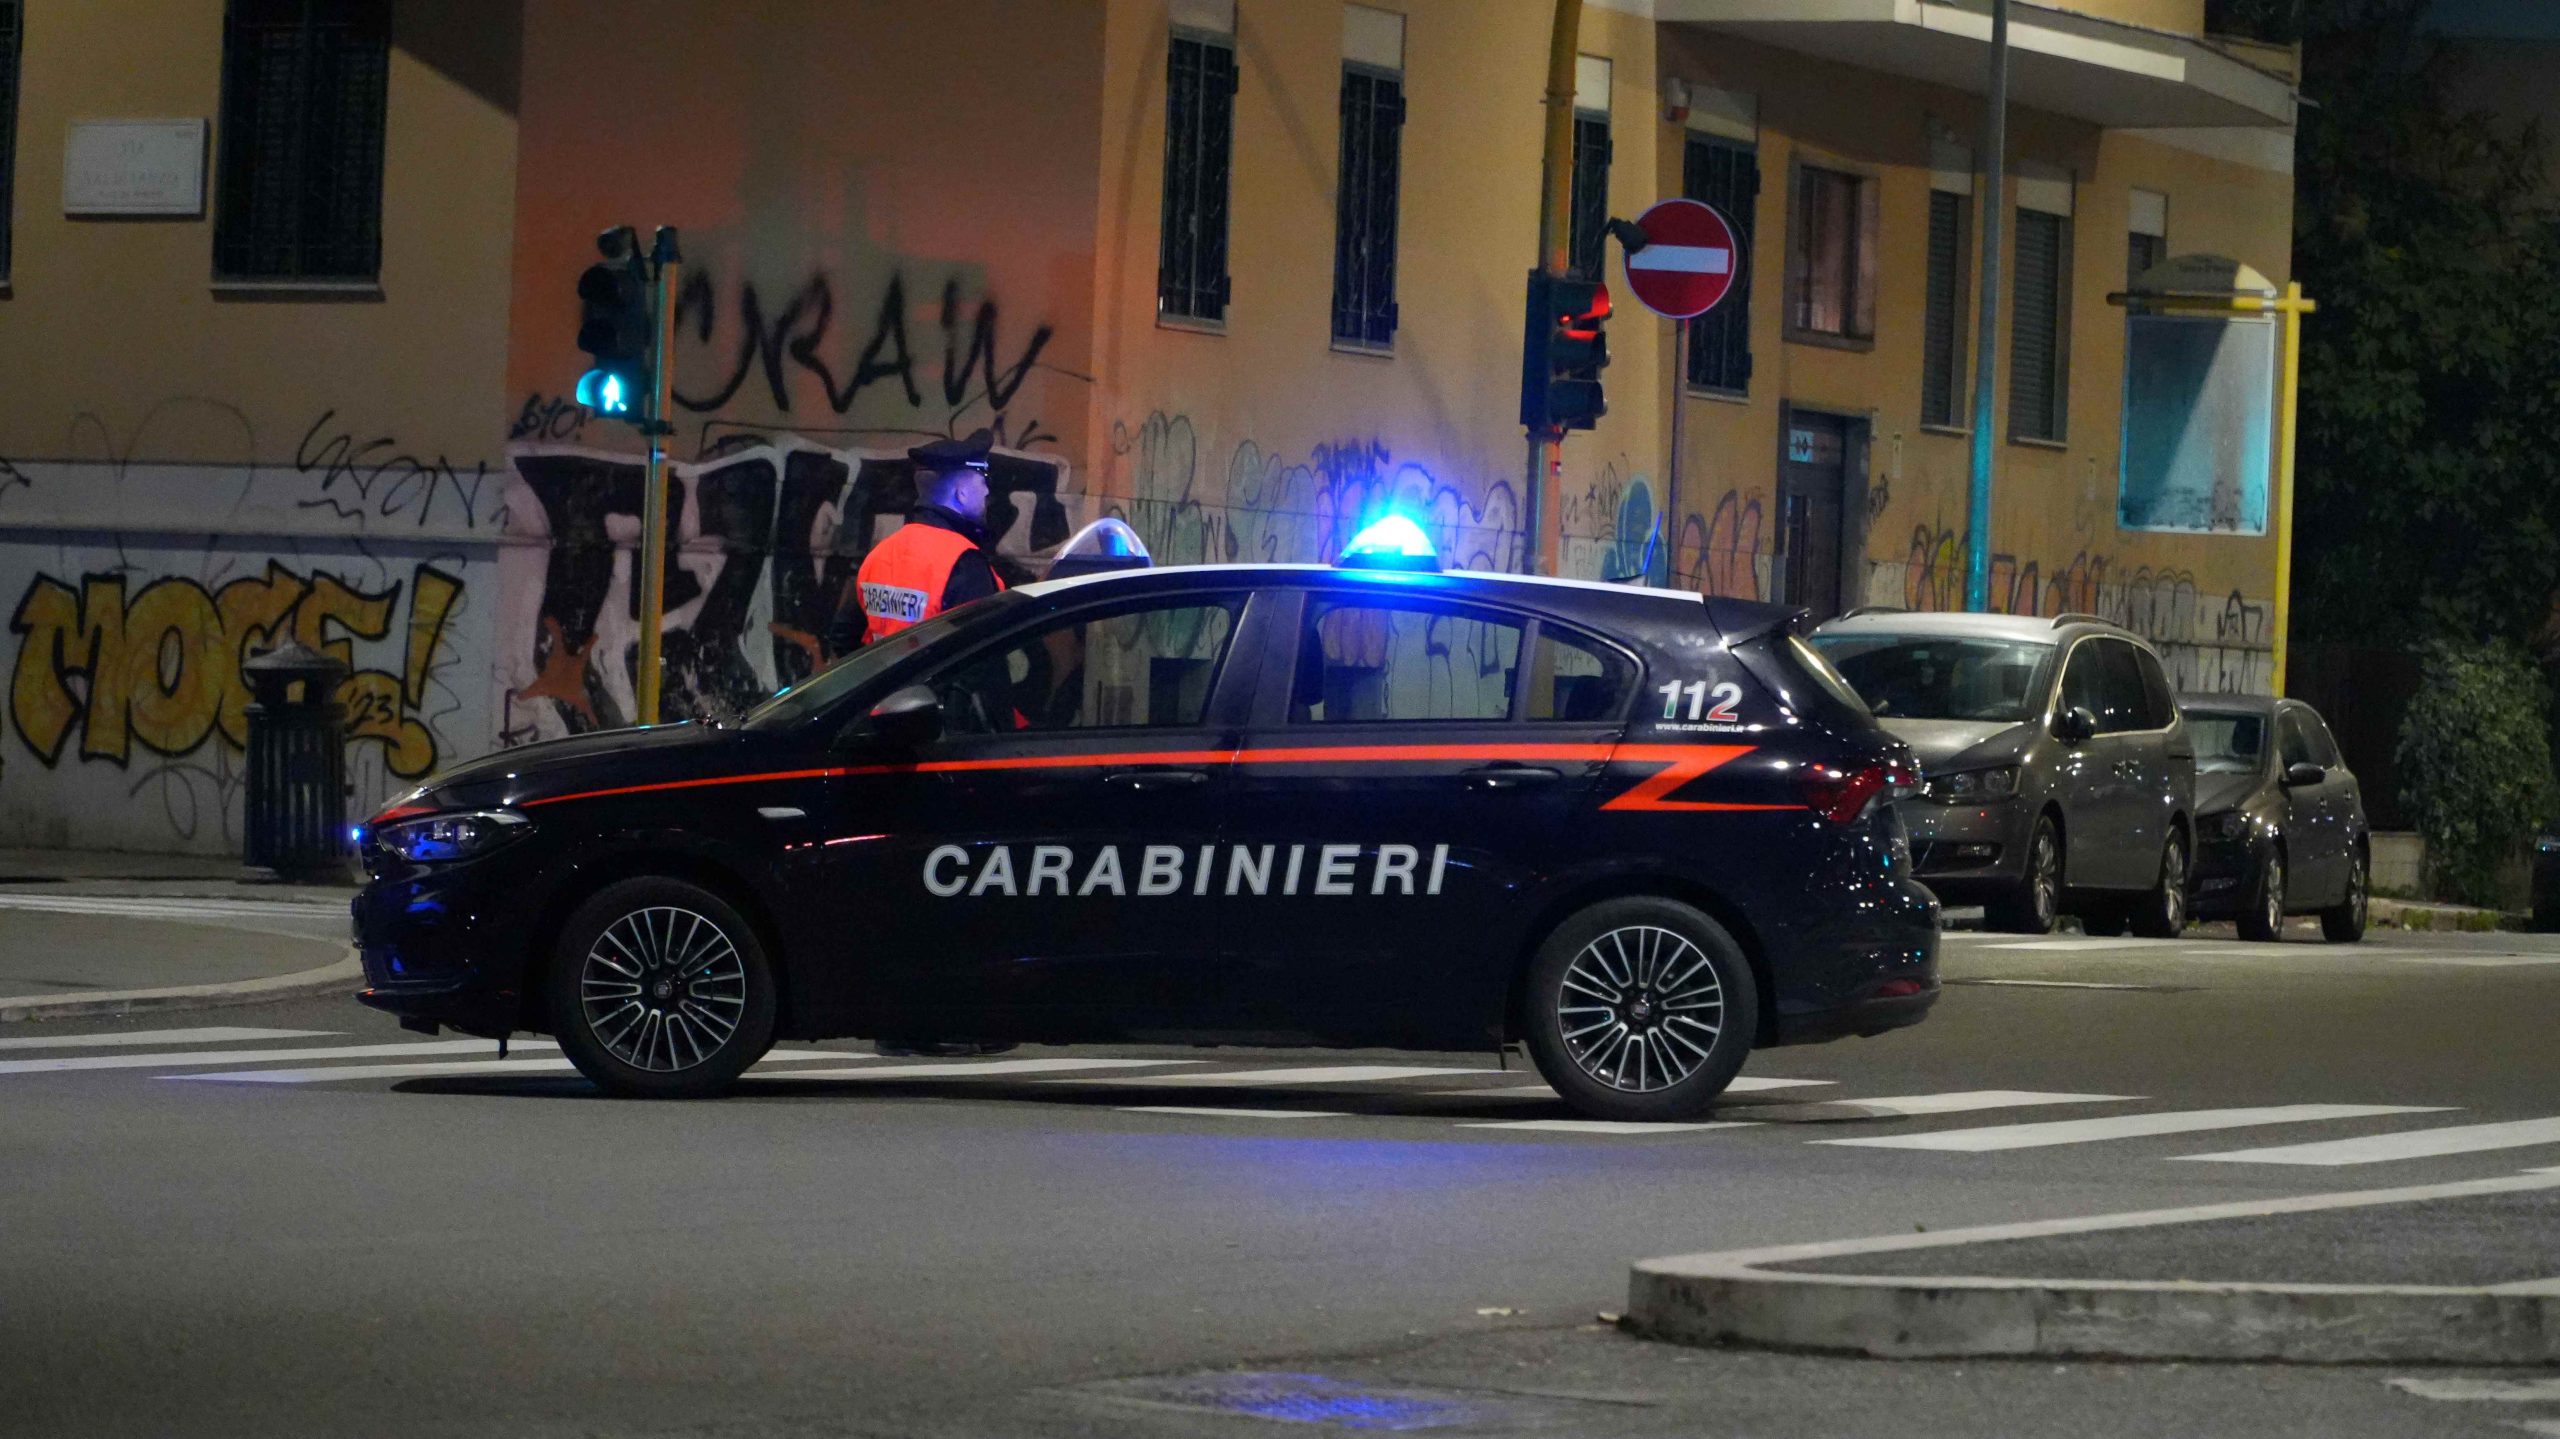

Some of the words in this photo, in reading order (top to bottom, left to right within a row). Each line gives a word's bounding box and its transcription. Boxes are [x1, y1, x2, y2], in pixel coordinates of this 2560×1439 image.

[861, 586, 923, 618] CARABINIERI
[1659, 680, 1743, 722] 112
[1655, 723, 1744, 732] www.carabinieri.it
[923, 843, 1450, 896] CARABINIERI
